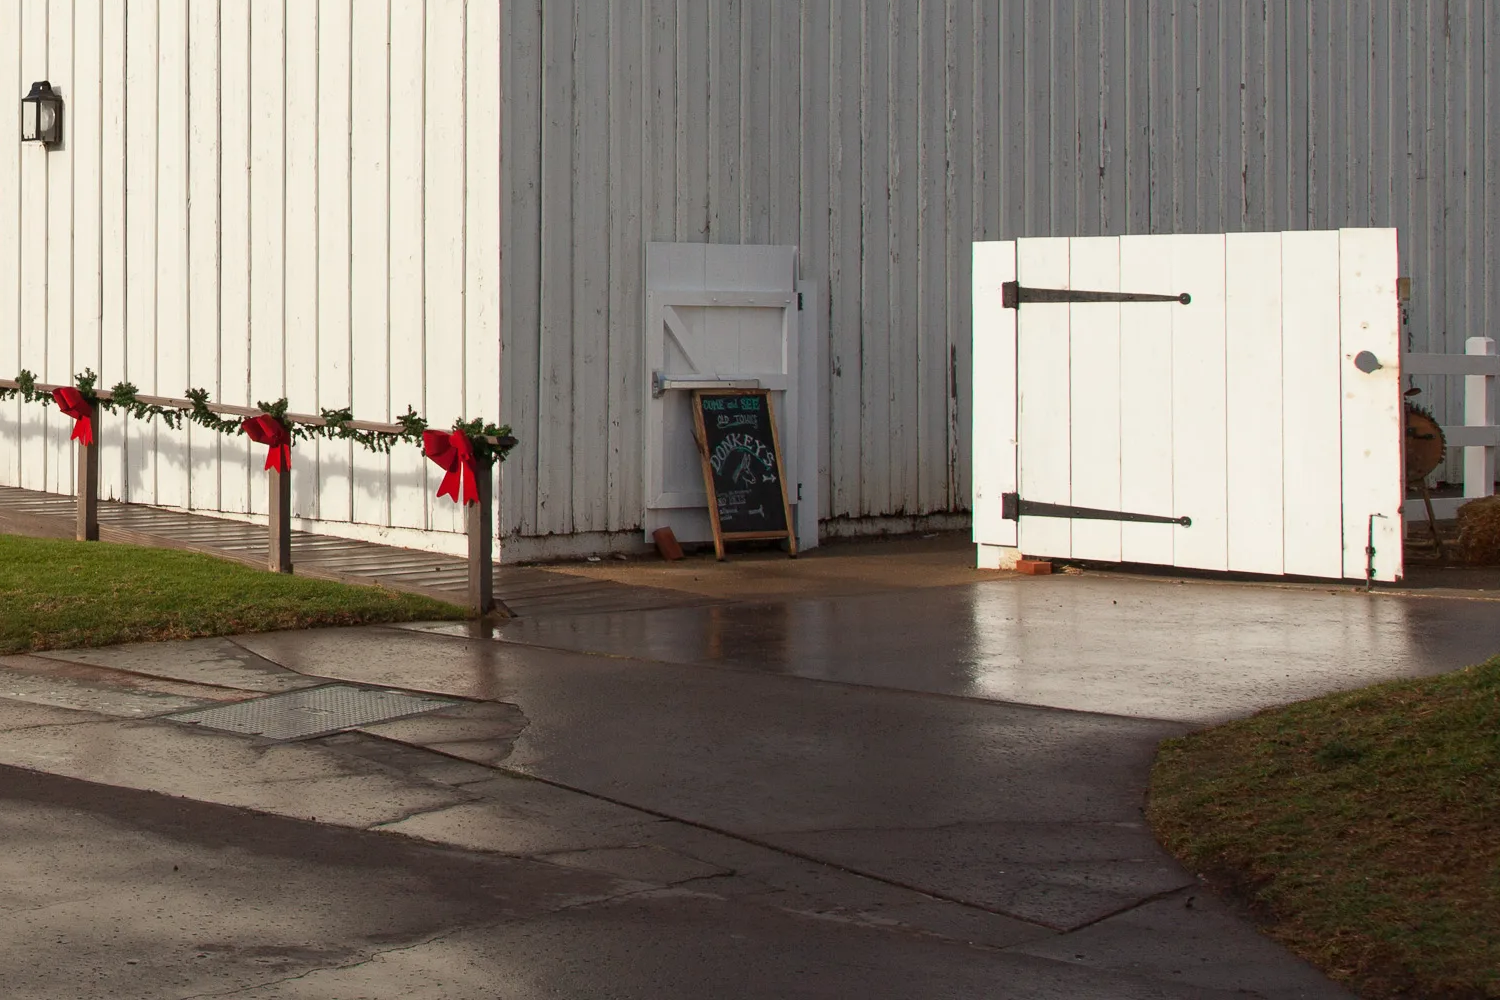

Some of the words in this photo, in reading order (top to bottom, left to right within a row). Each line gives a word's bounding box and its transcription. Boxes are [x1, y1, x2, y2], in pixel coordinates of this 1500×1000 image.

[703, 399, 724, 411] COME
[740, 397, 760, 410] SEE
[717, 414, 729, 424] OLD
